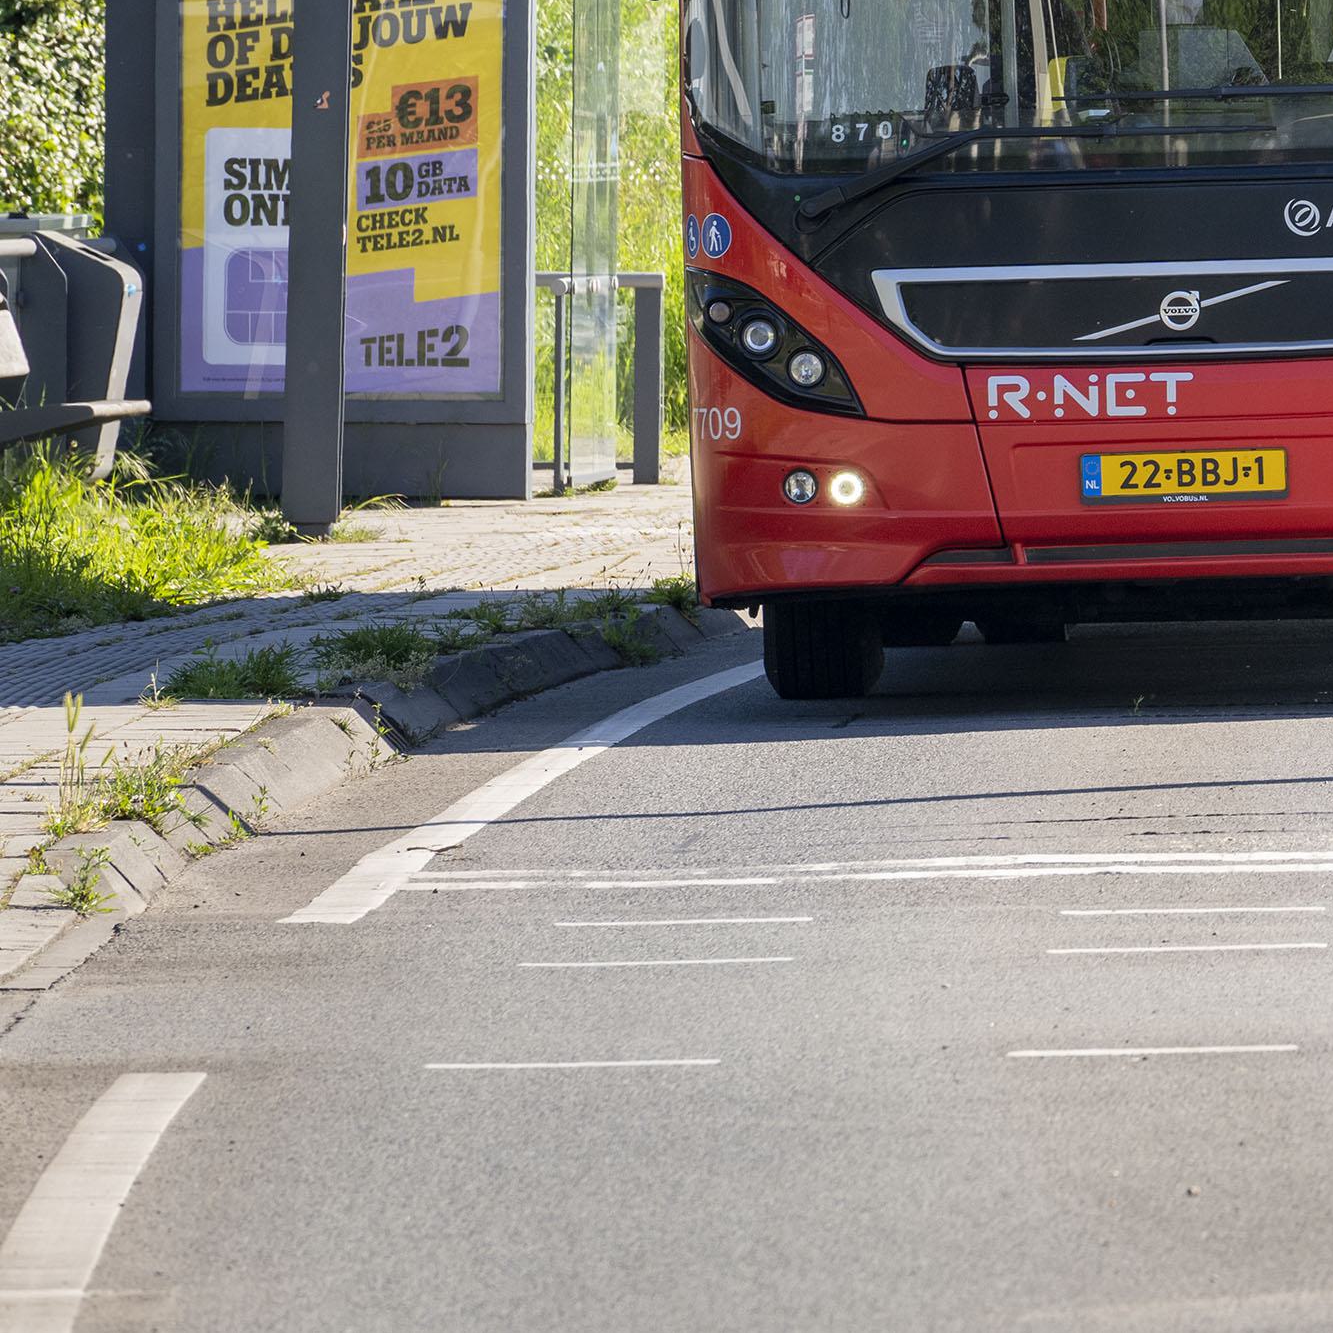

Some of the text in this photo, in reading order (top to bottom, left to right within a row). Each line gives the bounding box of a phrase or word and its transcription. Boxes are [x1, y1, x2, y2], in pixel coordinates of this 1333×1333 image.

[206, 30, 260, 69] OF
[395, 84, 474, 130] €13
[366, 125, 460, 151] PER MAAND
[365, 160, 443, 205] 10 GB
[416, 175, 470, 199] DATA
[356, 207, 428, 232] CHECK
[356, 224, 460, 253] TELE2.NL
[360, 324, 470, 368] TELE2
[1085, 456, 1264, 490] NL 22-BBJ-1
